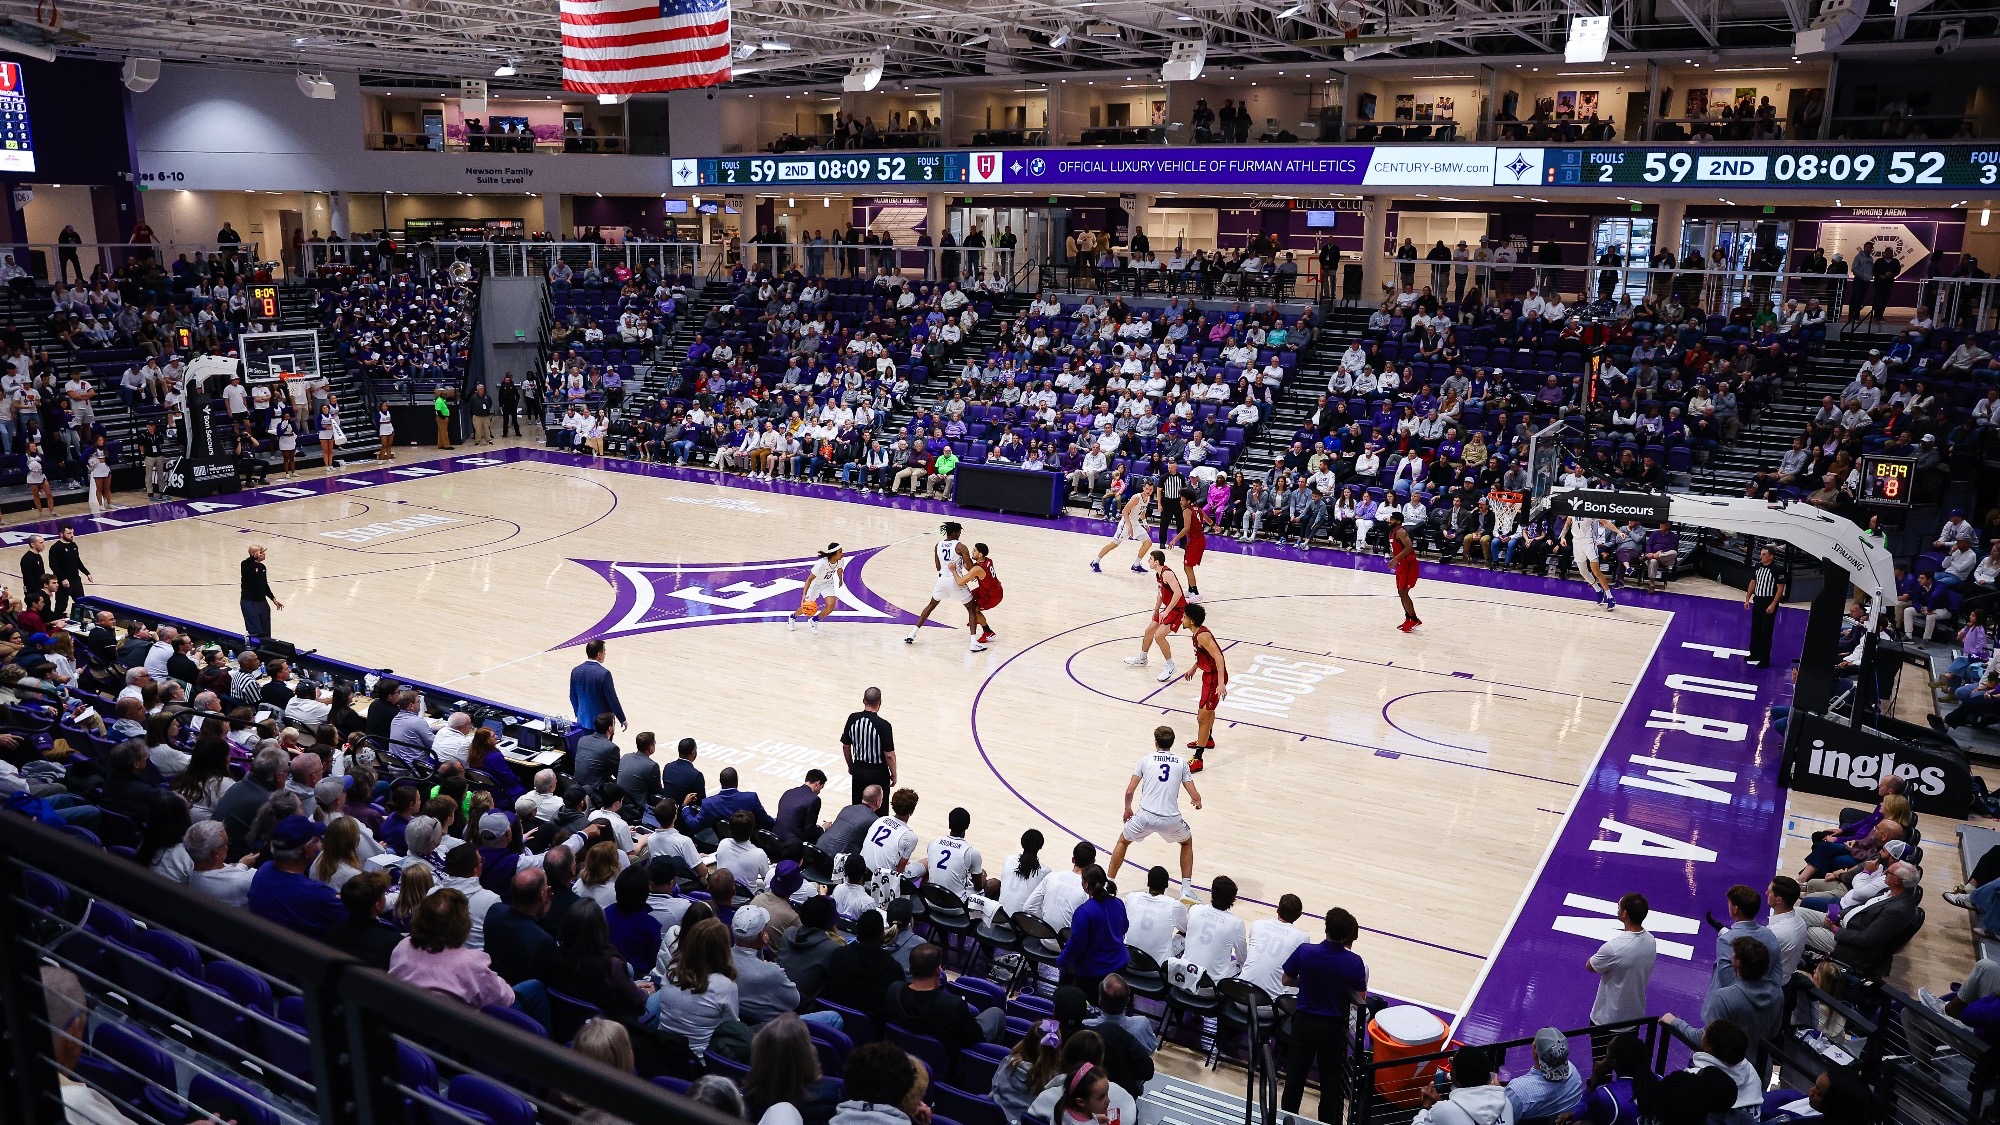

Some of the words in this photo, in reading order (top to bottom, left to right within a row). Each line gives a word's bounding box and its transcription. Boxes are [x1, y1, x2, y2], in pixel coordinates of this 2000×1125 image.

[917, 157, 940, 166] FOULS
[981, 157, 991, 173] H
[1590, 153, 1624, 164] FOULS
[1970, 151, 2000, 164] FOU
[465, 167, 503, 175] Newsom
[505, 167, 534, 176] Family
[721, 161, 740, 170] FOULS
[750, 160, 776, 182] 59
[784, 165, 809, 177] 2ND
[818, 159, 871, 180] 08:09
[876, 157, 906, 181] 52
[1058, 161, 1108, 173] OFFICIAL
[1110, 161, 1155, 172] LUXURY
[1156, 160, 1207, 172] VEHICLE
[1209, 160, 1227, 172] OF
[1229, 160, 1283, 172] FURMAN
[1285, 159, 1356, 172] ATHLETICS
[1374, 162, 1489, 174] CENTURY-BMW.com
[1643, 152, 1693, 183] 59
[1709, 160, 1755, 176] 2ND
[1774, 154, 1875, 181] 08:09
[1887, 151, 1946, 184] 52
[158, 171, 185, 182] 6-10
[477, 176, 499, 184] Suite
[501, 176, 524, 184] Level
[727, 170, 736, 183] 2
[923, 167, 933, 181] 3
[1598, 165, 1613, 182] 2
[1979, 165, 1998, 184] 3
[15, 193, 27, 202] 106
[731, 200, 743, 208] 103
[1296, 200, 1334, 209] ULTRA
[1337, 200, 1362, 209] CLU
[1852, 208, 1883, 216] TIMMONS
[1884, 209, 1907, 217] ARENA
[254, 287, 275, 299] 8:09
[263, 298, 275, 316] 8
[203, 414, 211, 429] Bon
[205, 429, 215, 456] Secours
[1876, 463, 1908, 478] 8:09
[1885, 479, 1899, 497] 8
[1584, 501, 1607, 513] Bon
[1608, 503, 1654, 516] Secours
[942, 548, 951, 562] 21
[1831, 542, 1866, 572] SPALDING
[1153, 755, 1179, 764] THOMAS
[1158, 763, 1171, 783] 3
[1807, 739, 1946, 796] ingles
[1551, 641, 1761, 961] FURMAN
[870, 825, 892, 848] 12
[936, 849, 952, 871] 2
[1140, 909, 1156, 932] 6
[1200, 911, 1226, 925] SMITH
[1199, 921, 1218, 946] 5
